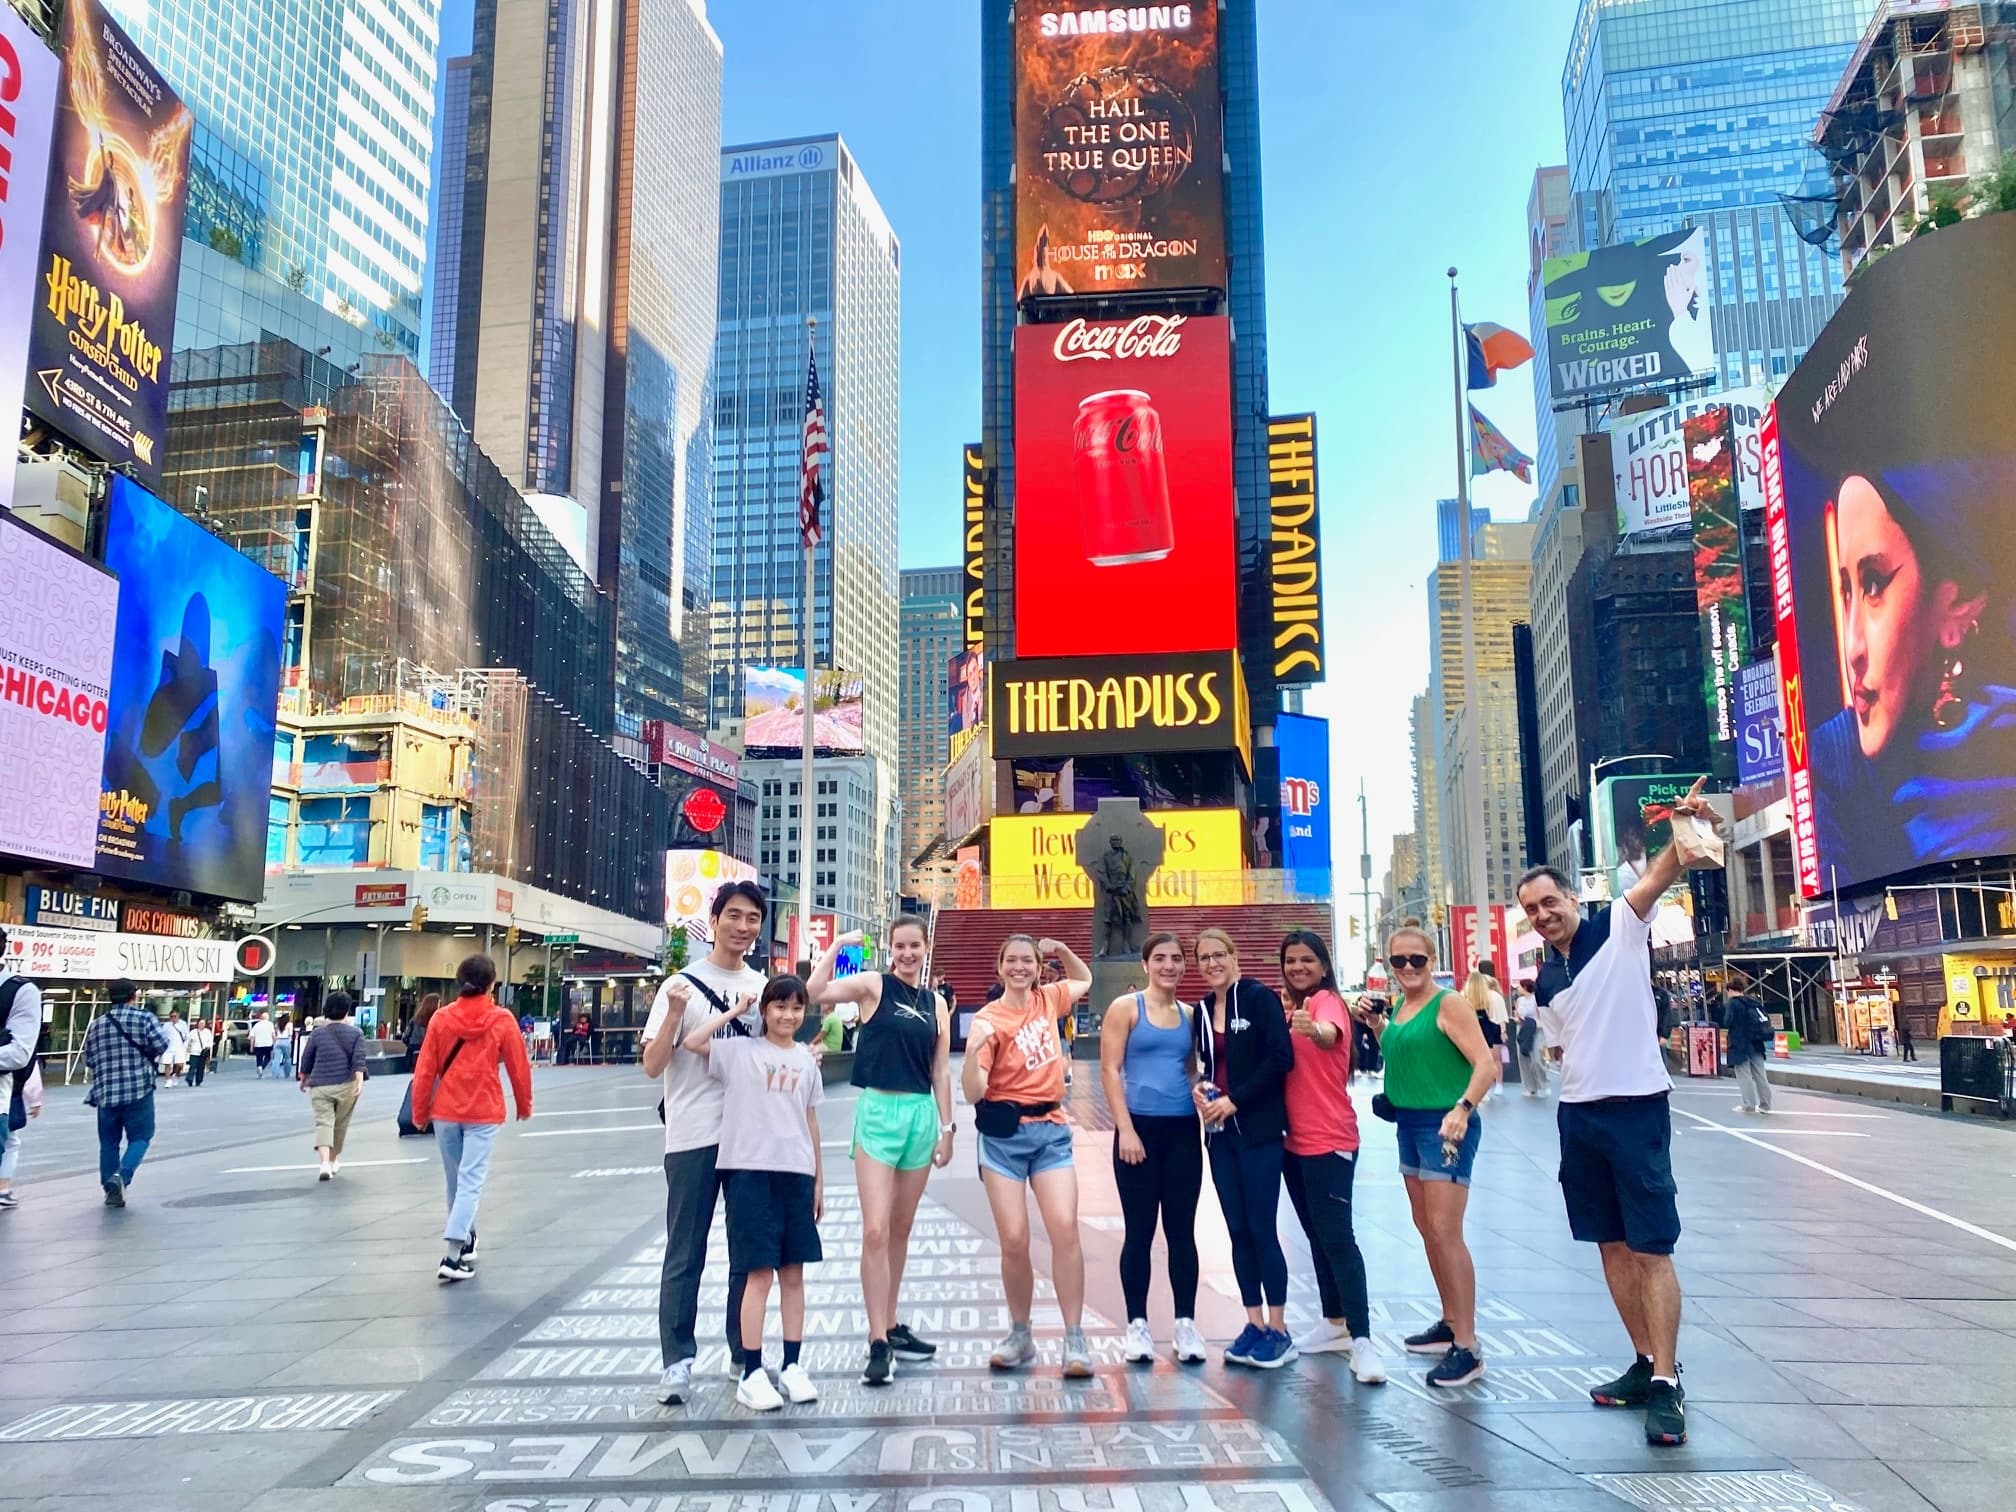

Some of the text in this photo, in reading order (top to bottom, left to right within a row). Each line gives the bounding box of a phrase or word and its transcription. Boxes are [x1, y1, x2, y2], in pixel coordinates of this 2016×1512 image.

[1040, 4, 1191, 36] SAMSUNG
[102, 23, 162, 100] BROADWAY'S
[1089, 98, 1144, 118] HAIL
[1064, 121, 1170, 145] THE ONE
[731, 155, 794, 174] Allianz
[1043, 146, 1192, 171] TRUE QUEEN
[1048, 244, 1099, 262] HOUSE
[1119, 239, 1197, 259] DRAGON
[1088, 229, 1153, 243] HBO ORIGINAL
[46, 253, 161, 385] Harry Potter
[1561, 317, 1656, 346] Brains. Heart.
[1578, 334, 1640, 354] Courage.
[68, 330, 138, 392] CURSED CHILD
[1764, 437, 1784, 520] COME
[1771, 516, 1793, 622] INSIDE!
[1726, 622, 1740, 672] Canada.
[0, 646, 108, 699] UST KEEPS GETTING HOTTER
[1710, 601, 1731, 741] Embrace the off season.
[0, 664, 108, 733] HICAGO
[1005, 672, 1221, 734] THERAPUSS
[711, 756, 736, 776] PLAZA
[1648, 784, 1678, 795] Pick
[99, 791, 121, 819] arry
[1032, 826, 1076, 857] New
[39, 889, 118, 919] BLUE FIN
[127, 908, 150, 932] DOS
[151, 911, 200, 939] CAMINOS
[32, 941, 96, 957] 99¢ LUGGAGE
[118, 941, 221, 974] SWAROVSKI
[62, 959, 70, 973] 3
[0, 1392, 390, 1438] HIRSCHFELD
[429, 1402, 702, 1425] MAJESTIC
[996, 1423, 1264, 1446] HAYES
[364, 1429, 978, 1484] JAMES ST
[997, 1443, 1283, 1468] HELEN
[1611, 1475, 1835, 1504] SONDHEIM
